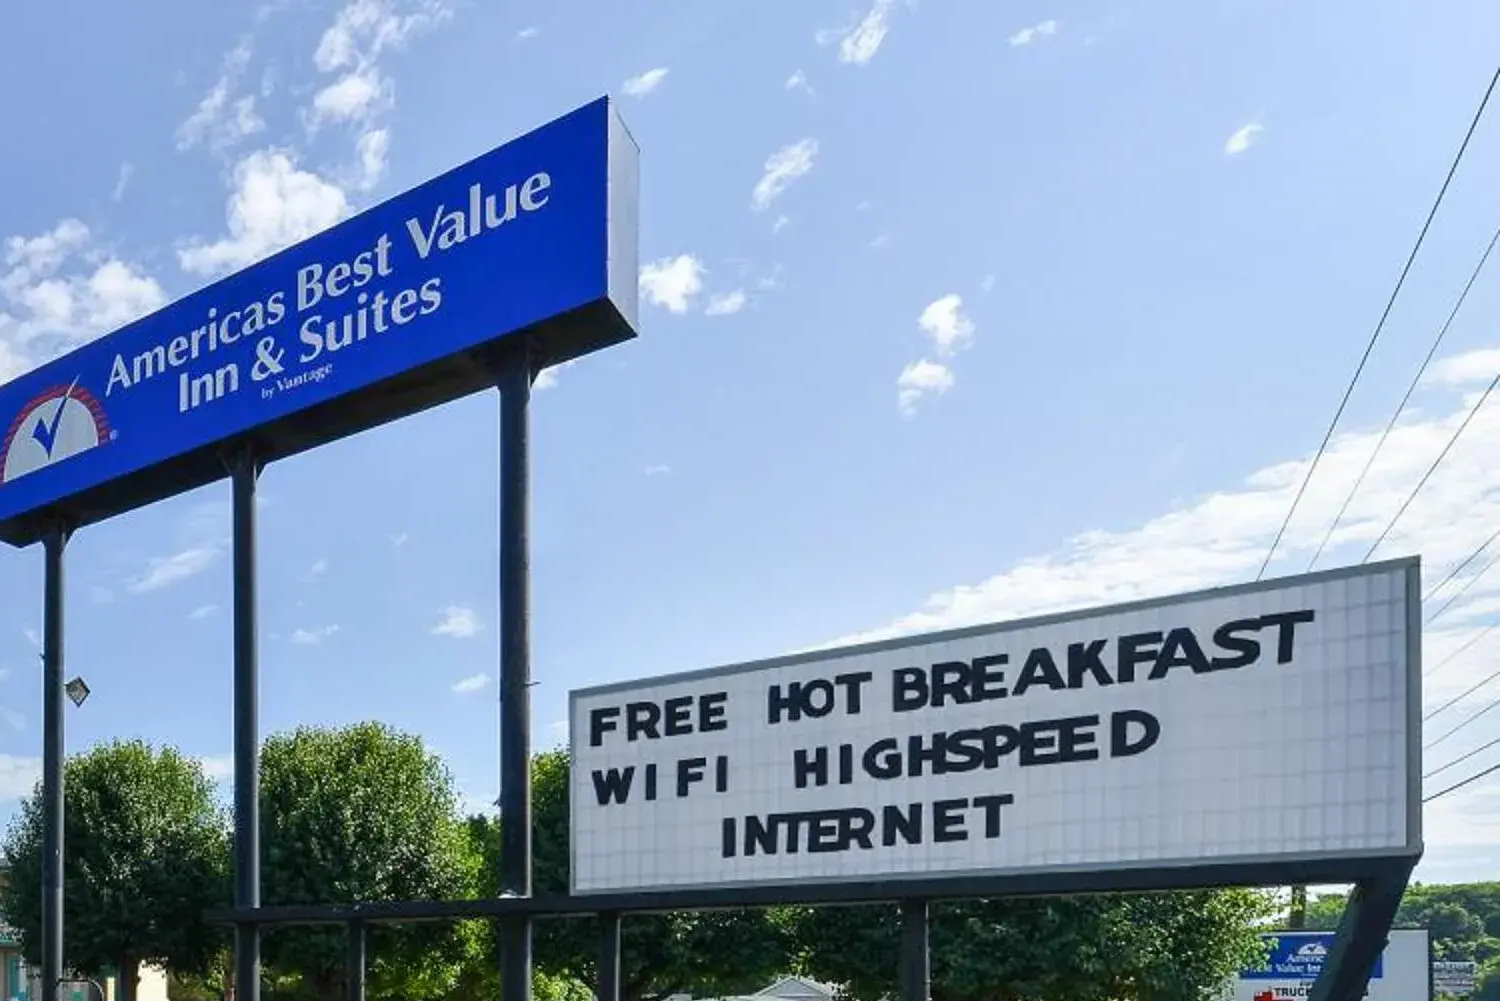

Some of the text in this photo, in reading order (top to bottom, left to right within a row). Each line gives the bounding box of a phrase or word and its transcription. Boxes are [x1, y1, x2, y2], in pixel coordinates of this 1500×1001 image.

[105, 172, 551, 398] Americas Best Value
[179, 278, 442, 413] Inn & Suites
[261, 363, 333, 400] by Vantage
[590, 610, 1315, 747] FREE HOT BREAKFAST
[591, 709, 1162, 806] WIFI HIGHSPEED
[722, 793, 1014, 859] INTERNET
[1276, 963, 1304, 973] Value
[1286, 953, 1324, 963] Americ
